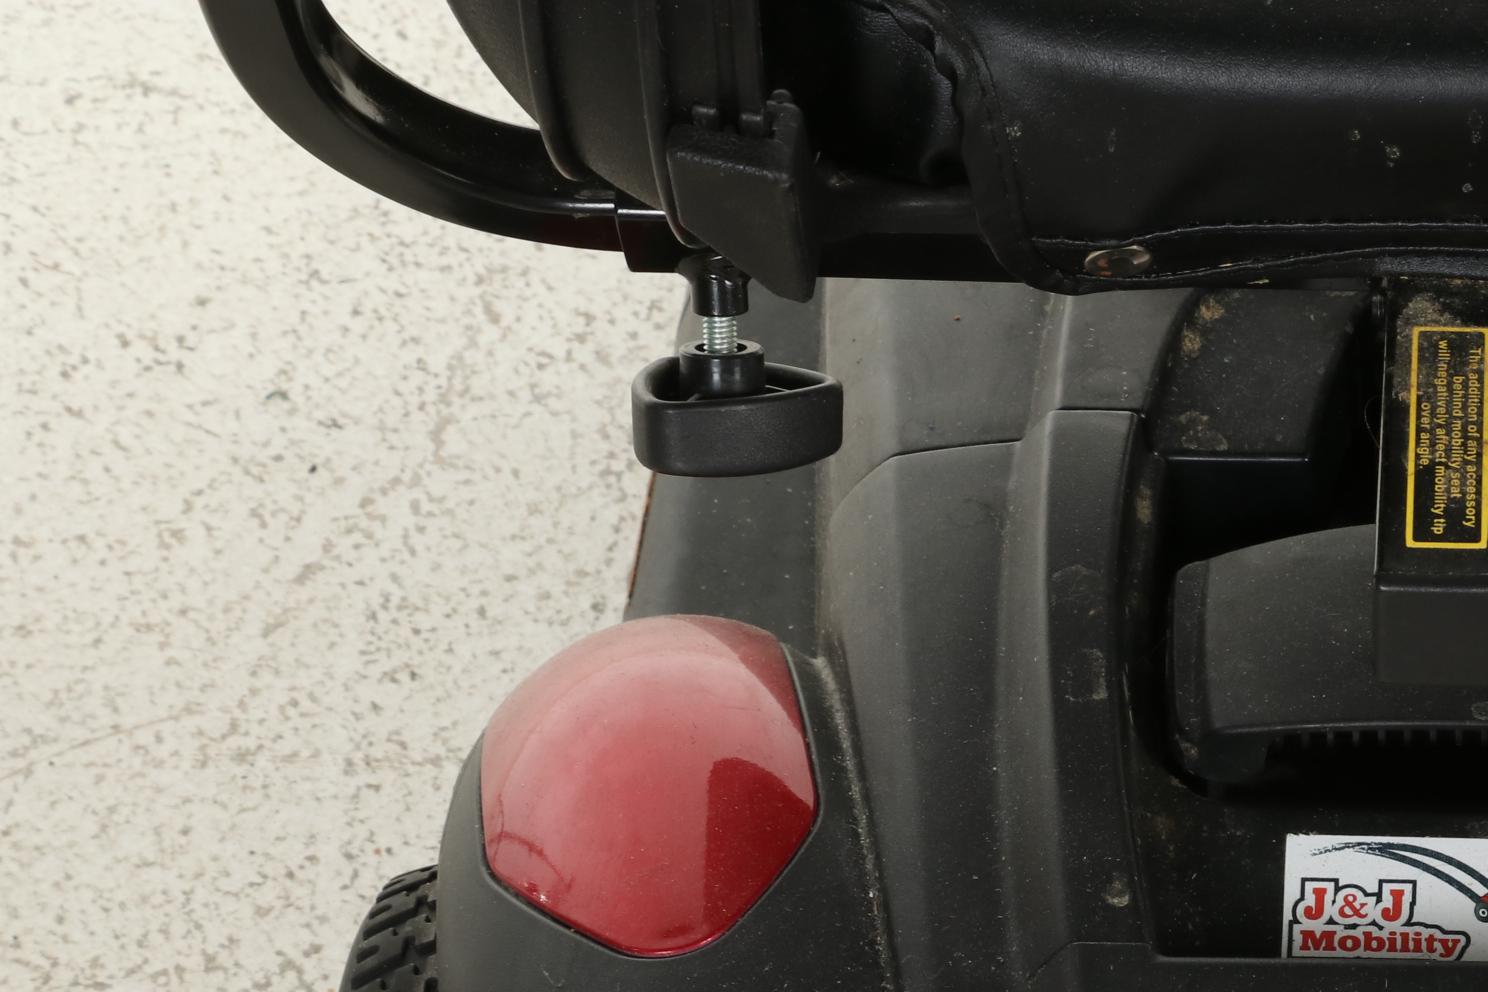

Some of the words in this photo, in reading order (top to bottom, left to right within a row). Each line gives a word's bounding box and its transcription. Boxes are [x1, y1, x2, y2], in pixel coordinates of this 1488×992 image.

[1437, 340, 1449, 360] will
[1469, 348, 1481, 369] The
[1434, 364, 1448, 424] negatively
[1452, 376, 1464, 416] behind
[1468, 372, 1480, 421] addition
[1421, 403, 1431, 428] over
[1468, 425, 1480, 436] of
[1417, 432, 1431, 468] angle.
[1435, 428, 1447, 462] affect
[1450, 420, 1464, 468] mobility
[1465, 440, 1478, 461] any
[1432, 466, 1447, 514] mobility
[1451, 472, 1462, 497] seat
[1463, 465, 1478, 527] accessory
[1431, 519, 1446, 534] tip
[1299, 929, 1460, 958] Mobility
